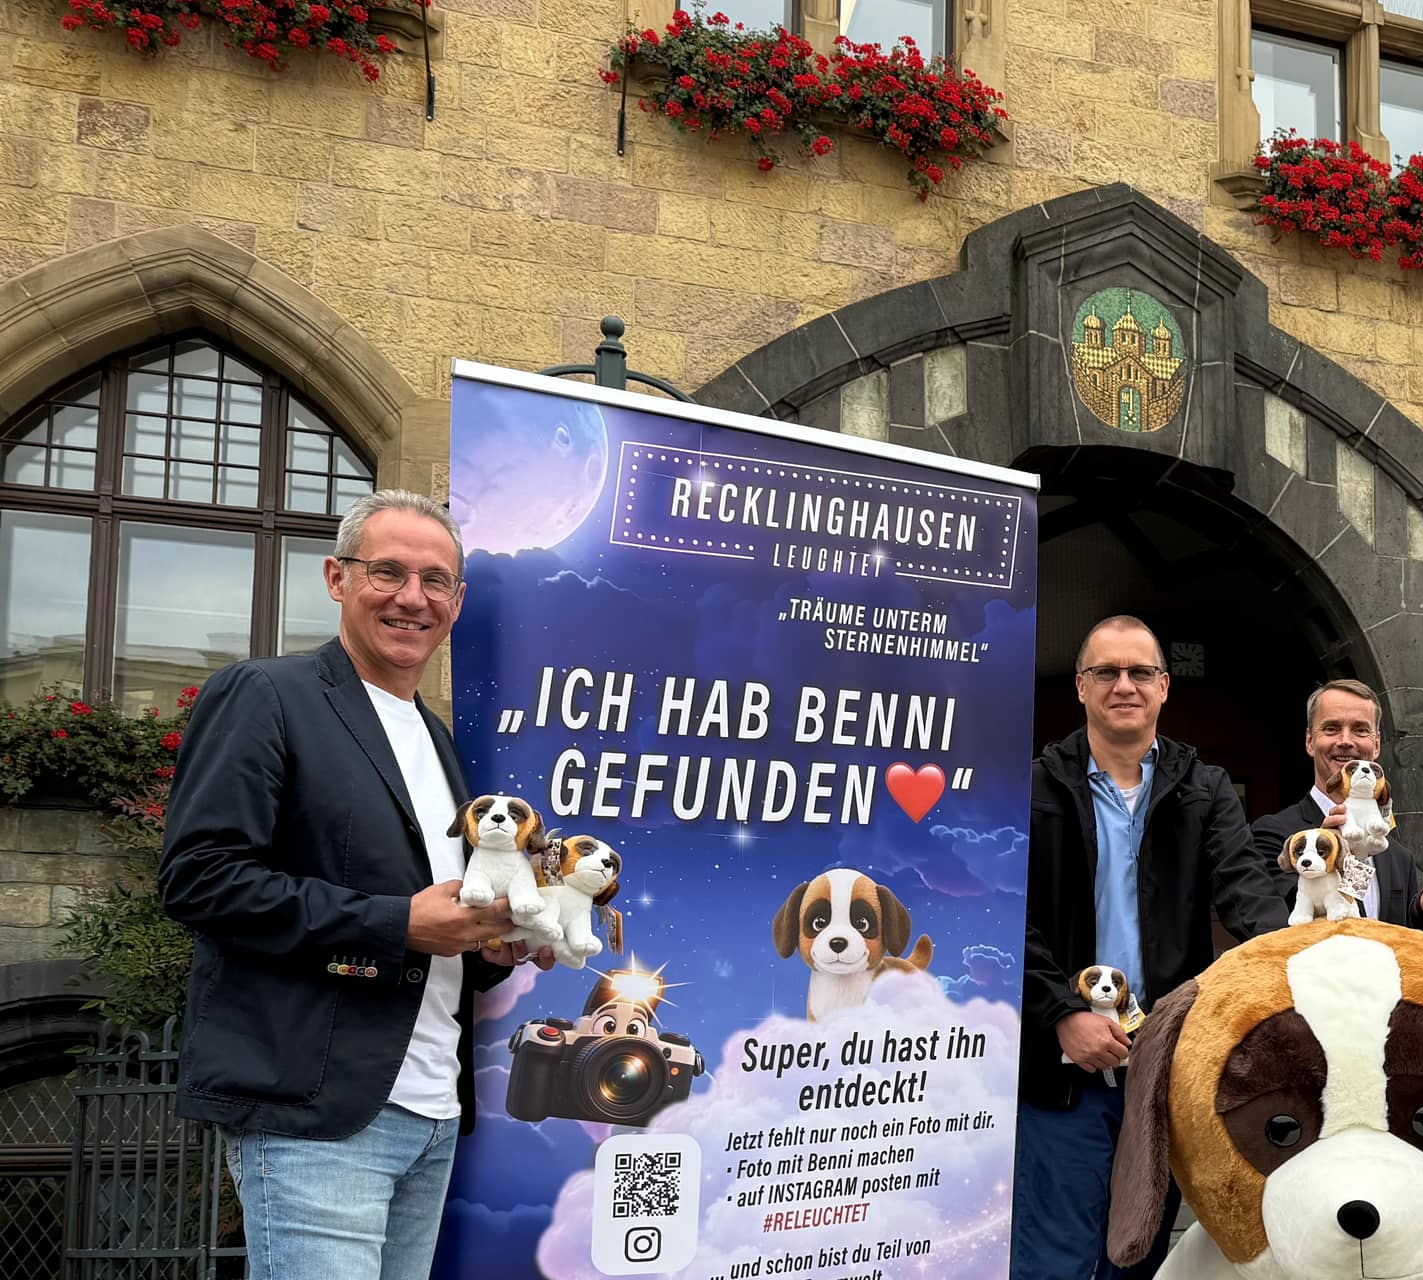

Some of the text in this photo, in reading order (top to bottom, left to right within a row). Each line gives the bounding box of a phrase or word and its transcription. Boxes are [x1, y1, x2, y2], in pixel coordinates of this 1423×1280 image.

[671, 478, 976, 551] RECKLINGHAUSEN
[773, 543, 883, 578] LEUCHTET
[778, 596, 947, 635] „TRÄUME UNTERM
[496, 666, 956, 752] „ICH HAB BENNI
[741, 1026, 986, 1078] Super, du hast ihn
[798, 1070, 928, 1111] entdeckt!
[726, 1110, 995, 1151] Jetzt fehlt nur noch ein Foto mit dir.
[736, 1145, 915, 1179] Foto mit Benni machen
[737, 1168, 941, 1207] auf INSTAGRAM posten mit
[763, 1202, 871, 1233] #RELEUCHTET
[730, 1256, 762, 1280] und
[765, 1252, 813, 1275] schon
[817, 1247, 849, 1269] bist
[852, 1244, 872, 1264] du
[876, 1239, 902, 1261] Teil
[905, 1239, 932, 1257] von
